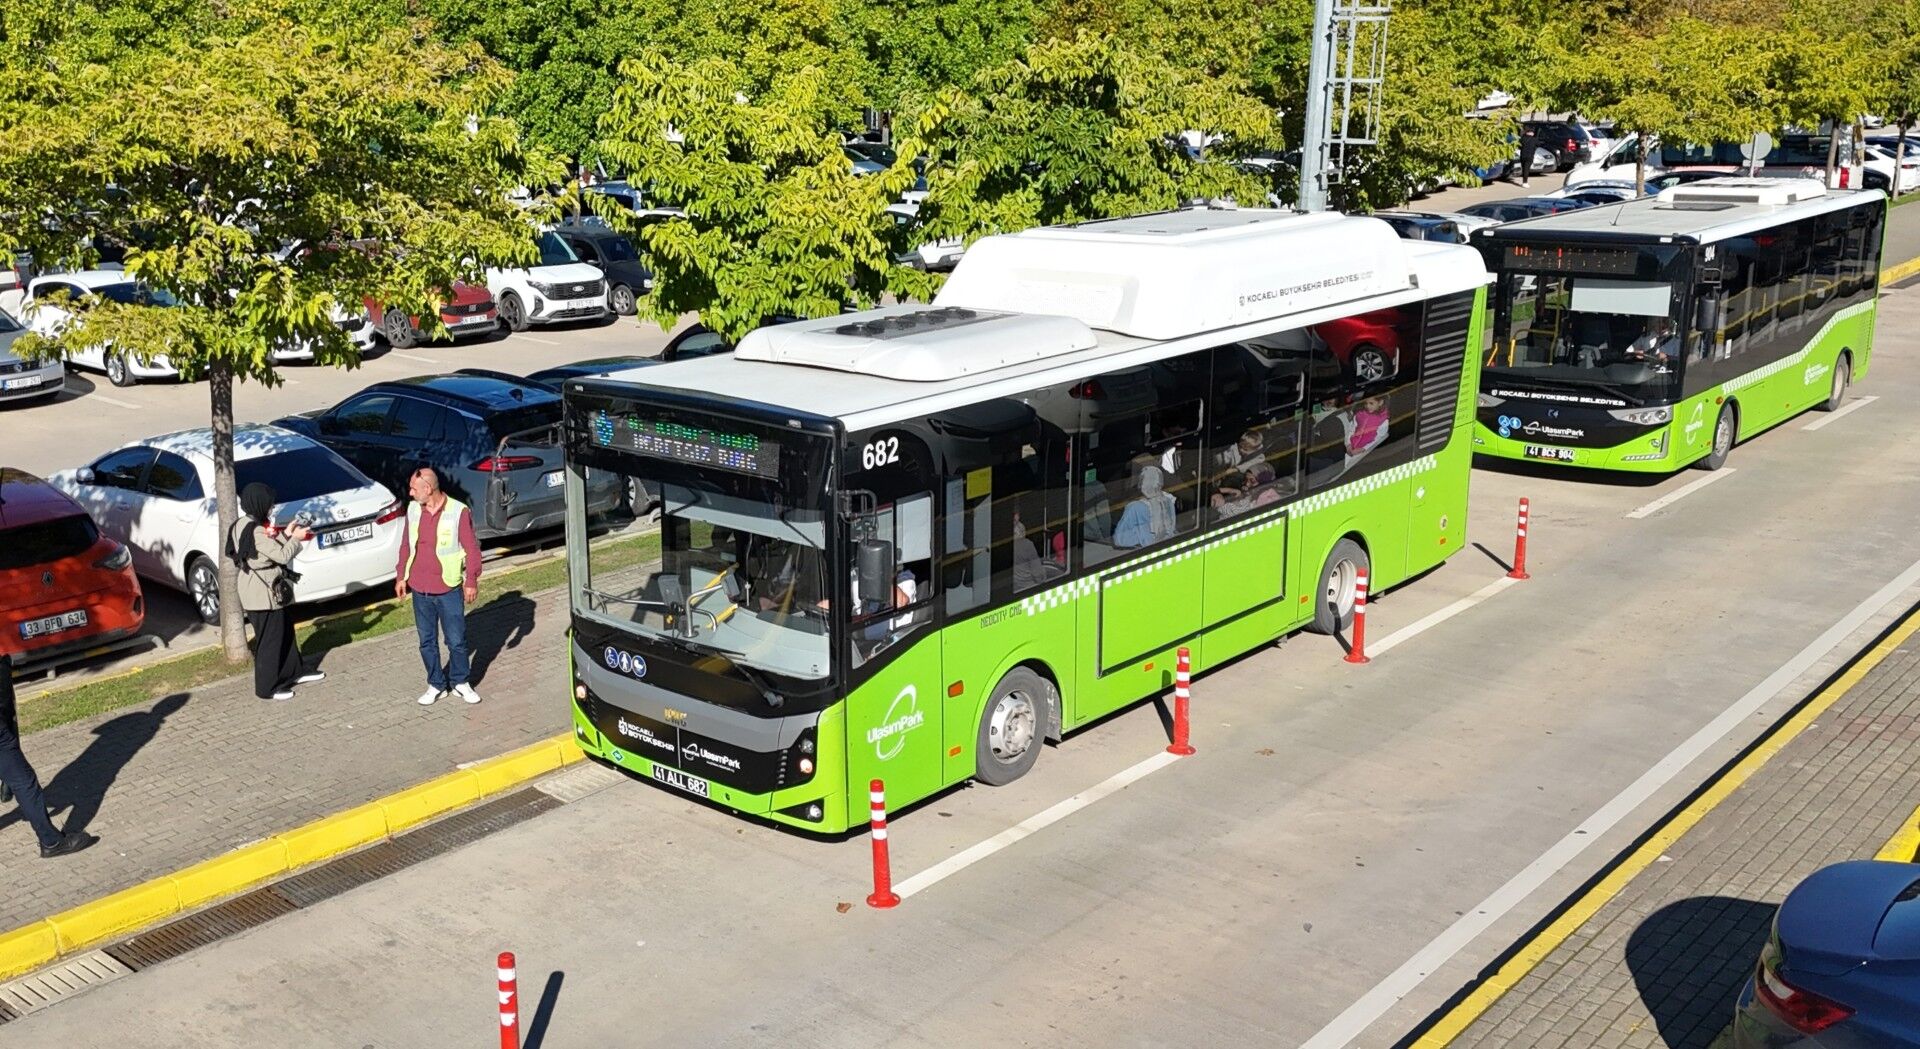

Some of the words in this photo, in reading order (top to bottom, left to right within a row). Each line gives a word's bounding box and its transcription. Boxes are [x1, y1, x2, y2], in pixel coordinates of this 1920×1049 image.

[862, 436, 899, 470] 682
[1529, 445, 1539, 456] 41
[27, 622, 39, 634] 33
[68, 613, 85, 625] 634
[655, 766, 665, 781] 41
[667, 771, 686, 788] ALL
[687, 777, 706, 796] 682
